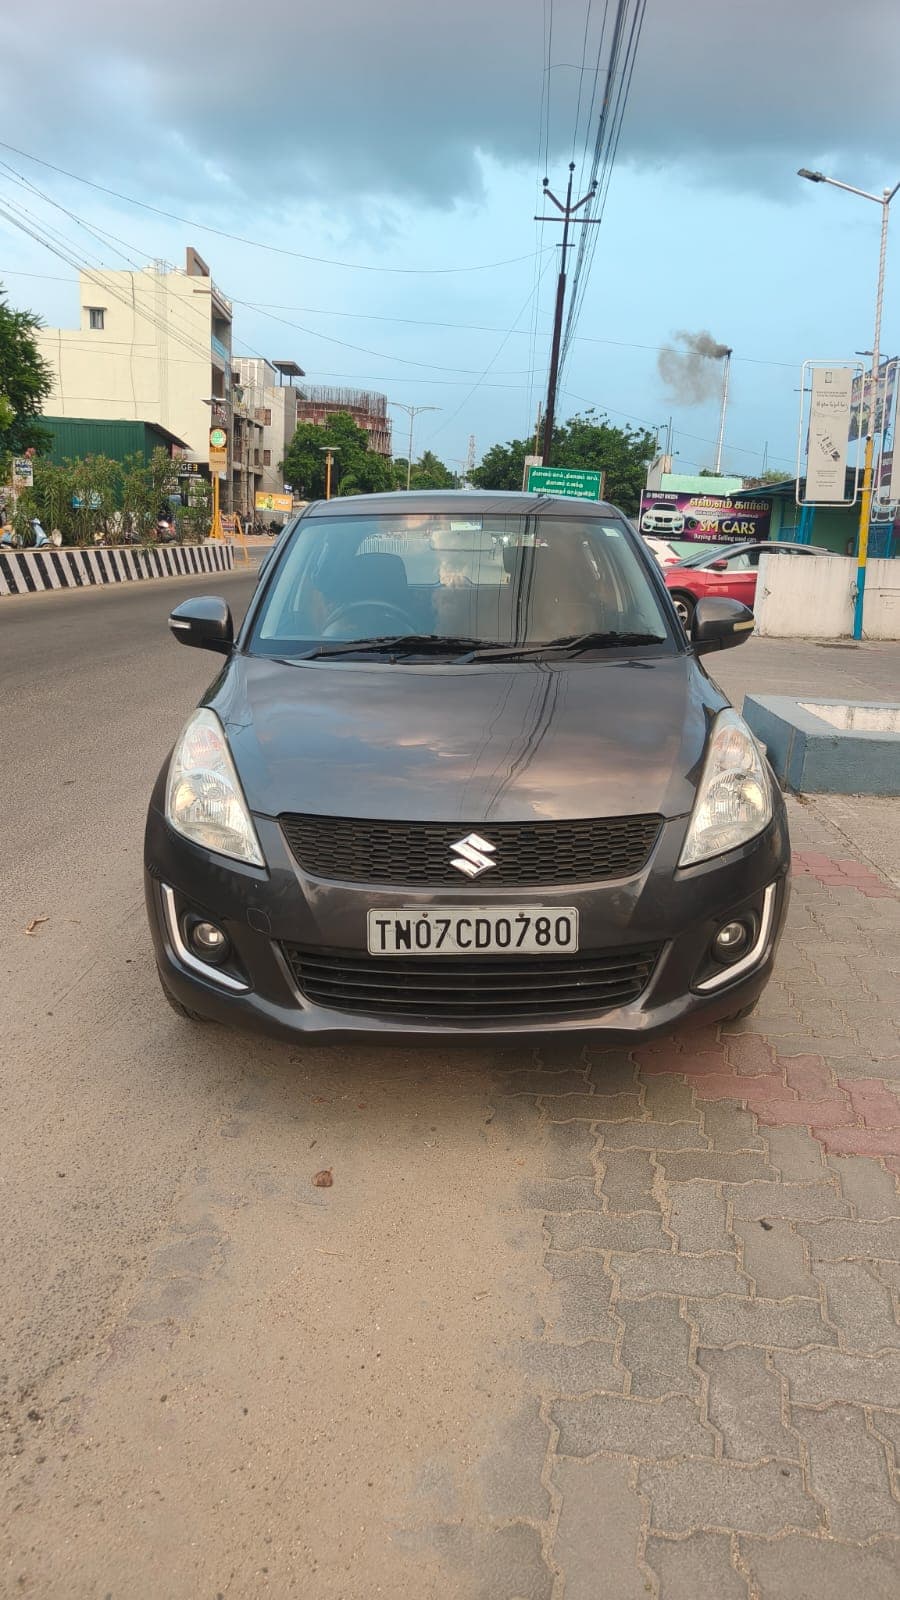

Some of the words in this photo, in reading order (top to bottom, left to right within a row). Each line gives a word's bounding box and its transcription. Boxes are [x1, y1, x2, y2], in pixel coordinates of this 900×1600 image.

[700, 520, 718, 533] SM
[722, 521, 756, 535] CARS
[375, 916, 571, 950] TN07CD0780
